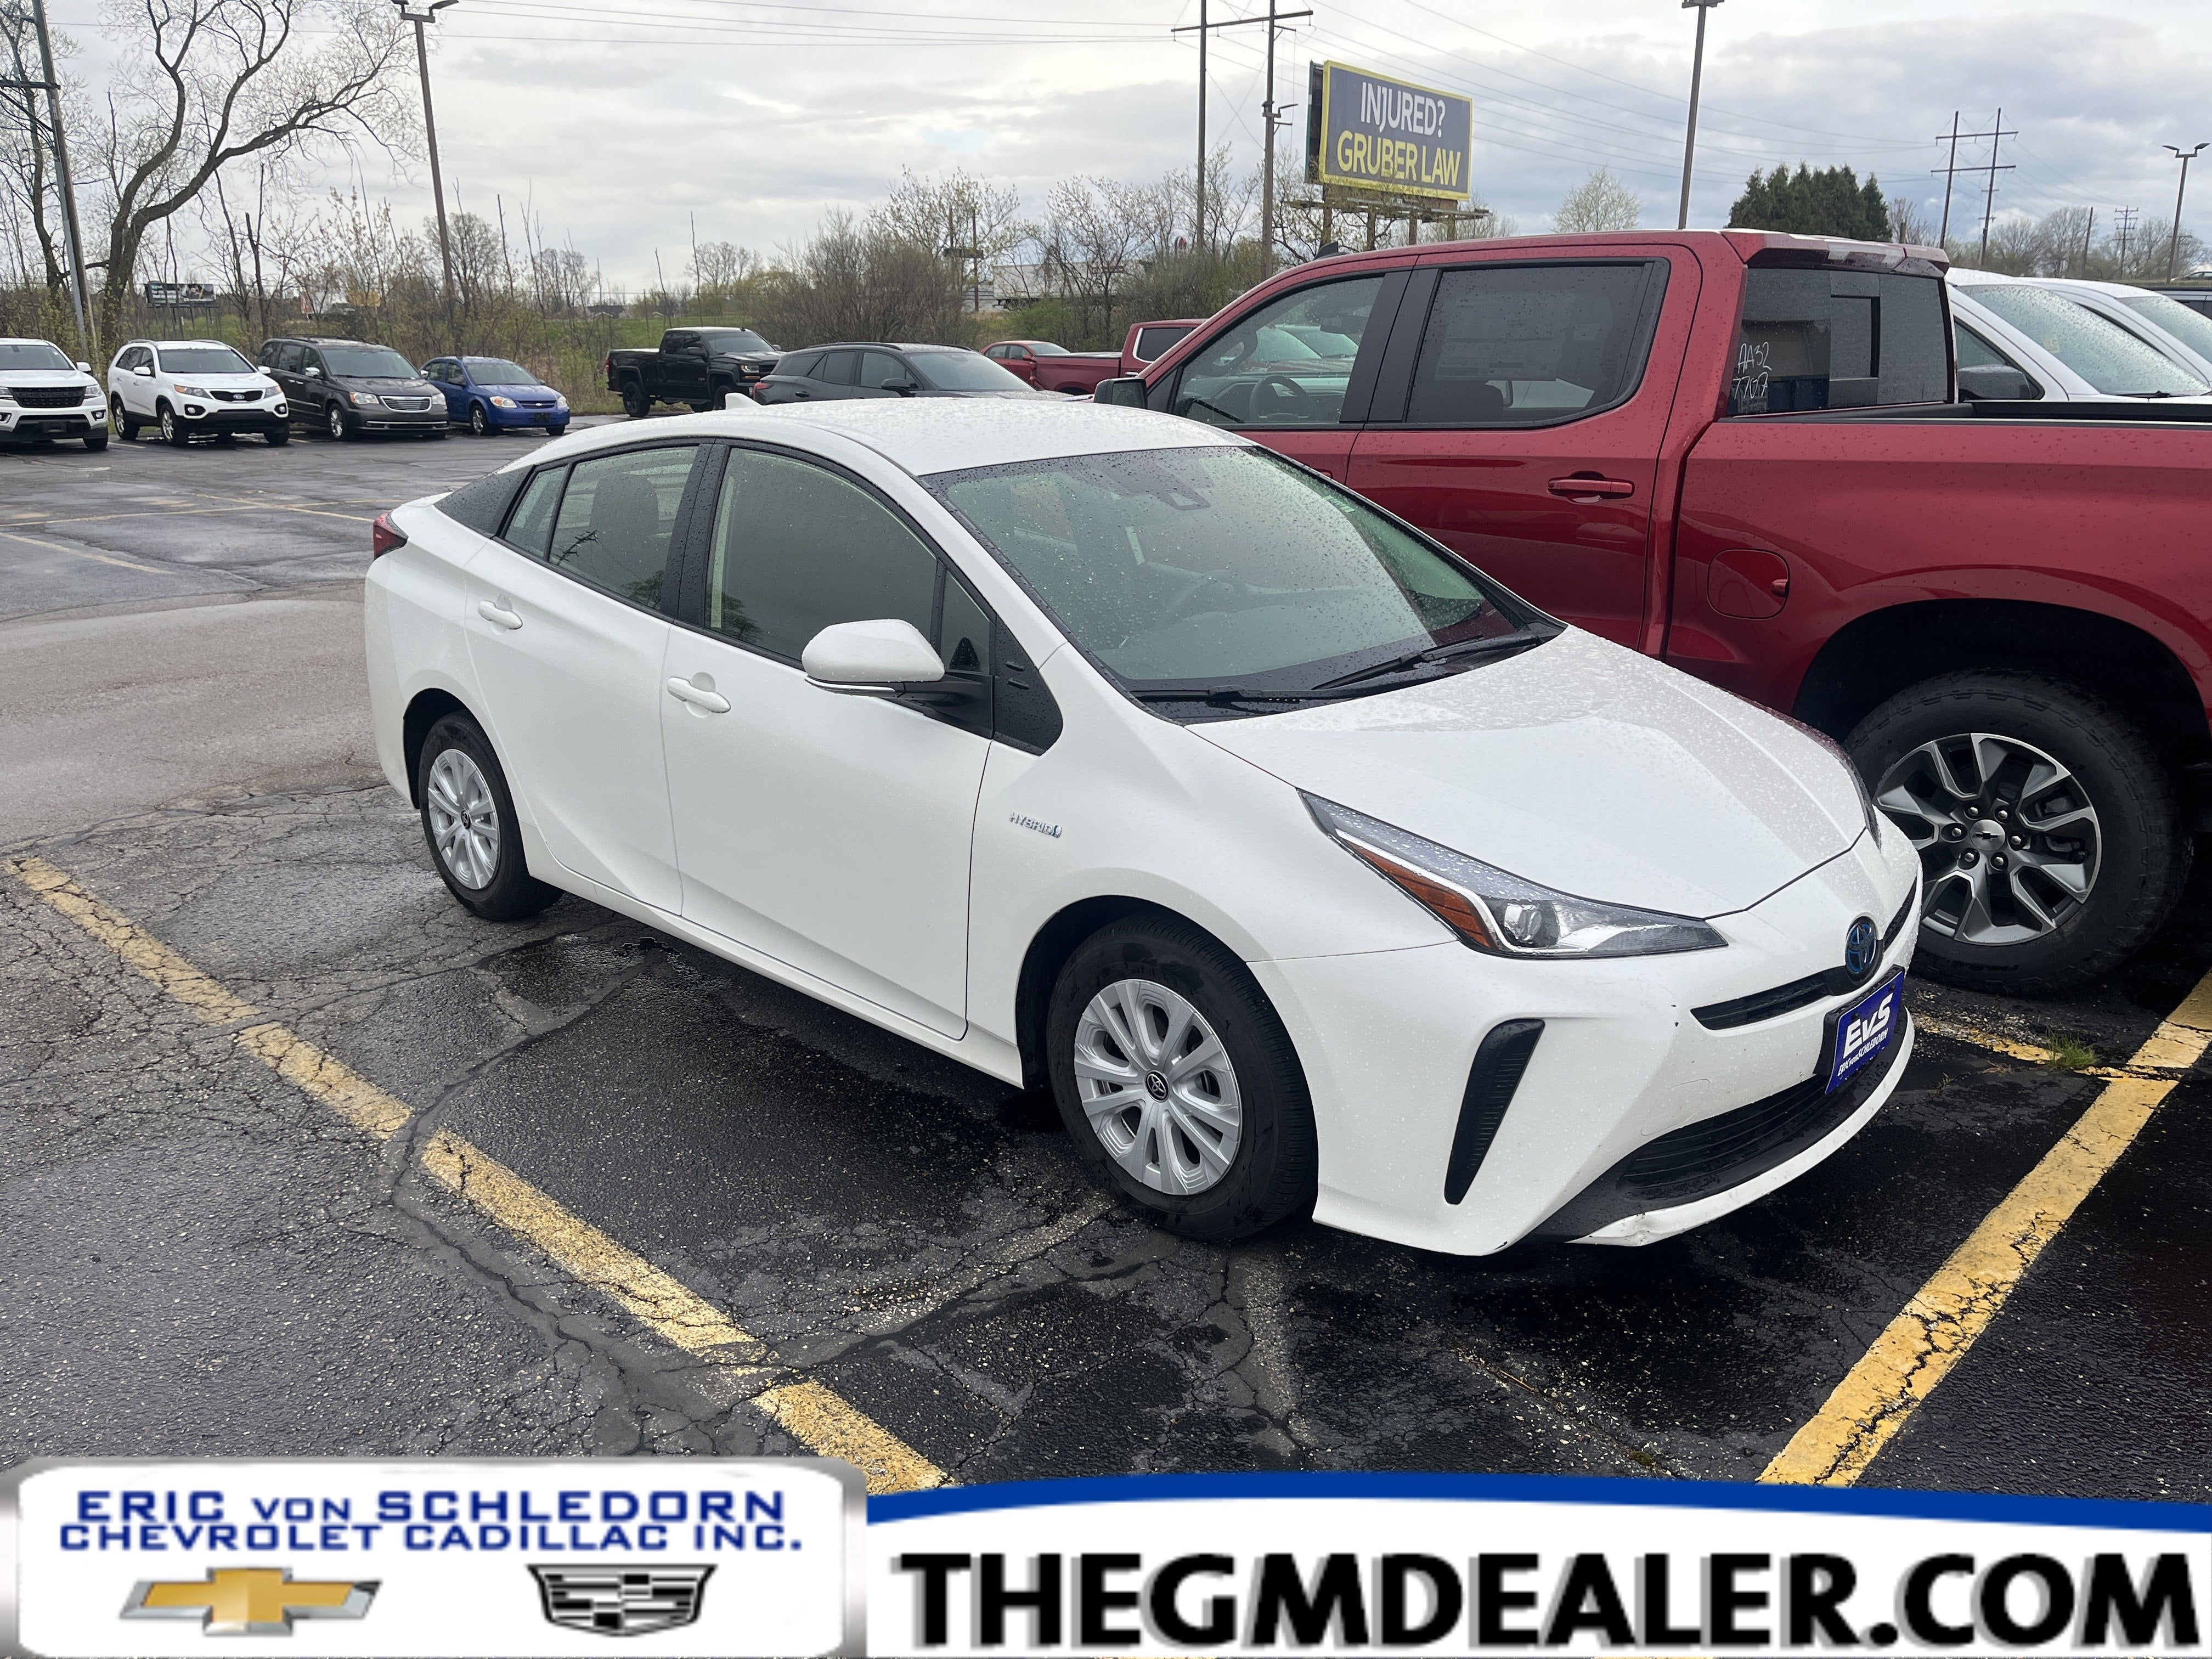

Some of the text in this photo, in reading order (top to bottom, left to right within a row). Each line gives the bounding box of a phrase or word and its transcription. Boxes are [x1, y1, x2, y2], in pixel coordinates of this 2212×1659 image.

[1360, 81, 1446, 138] INJURED?
[1337, 129, 1462, 187] GRUBER LAW
[1737, 341, 1773, 374] AA32
[1009, 811, 1054, 835] HYBRID
